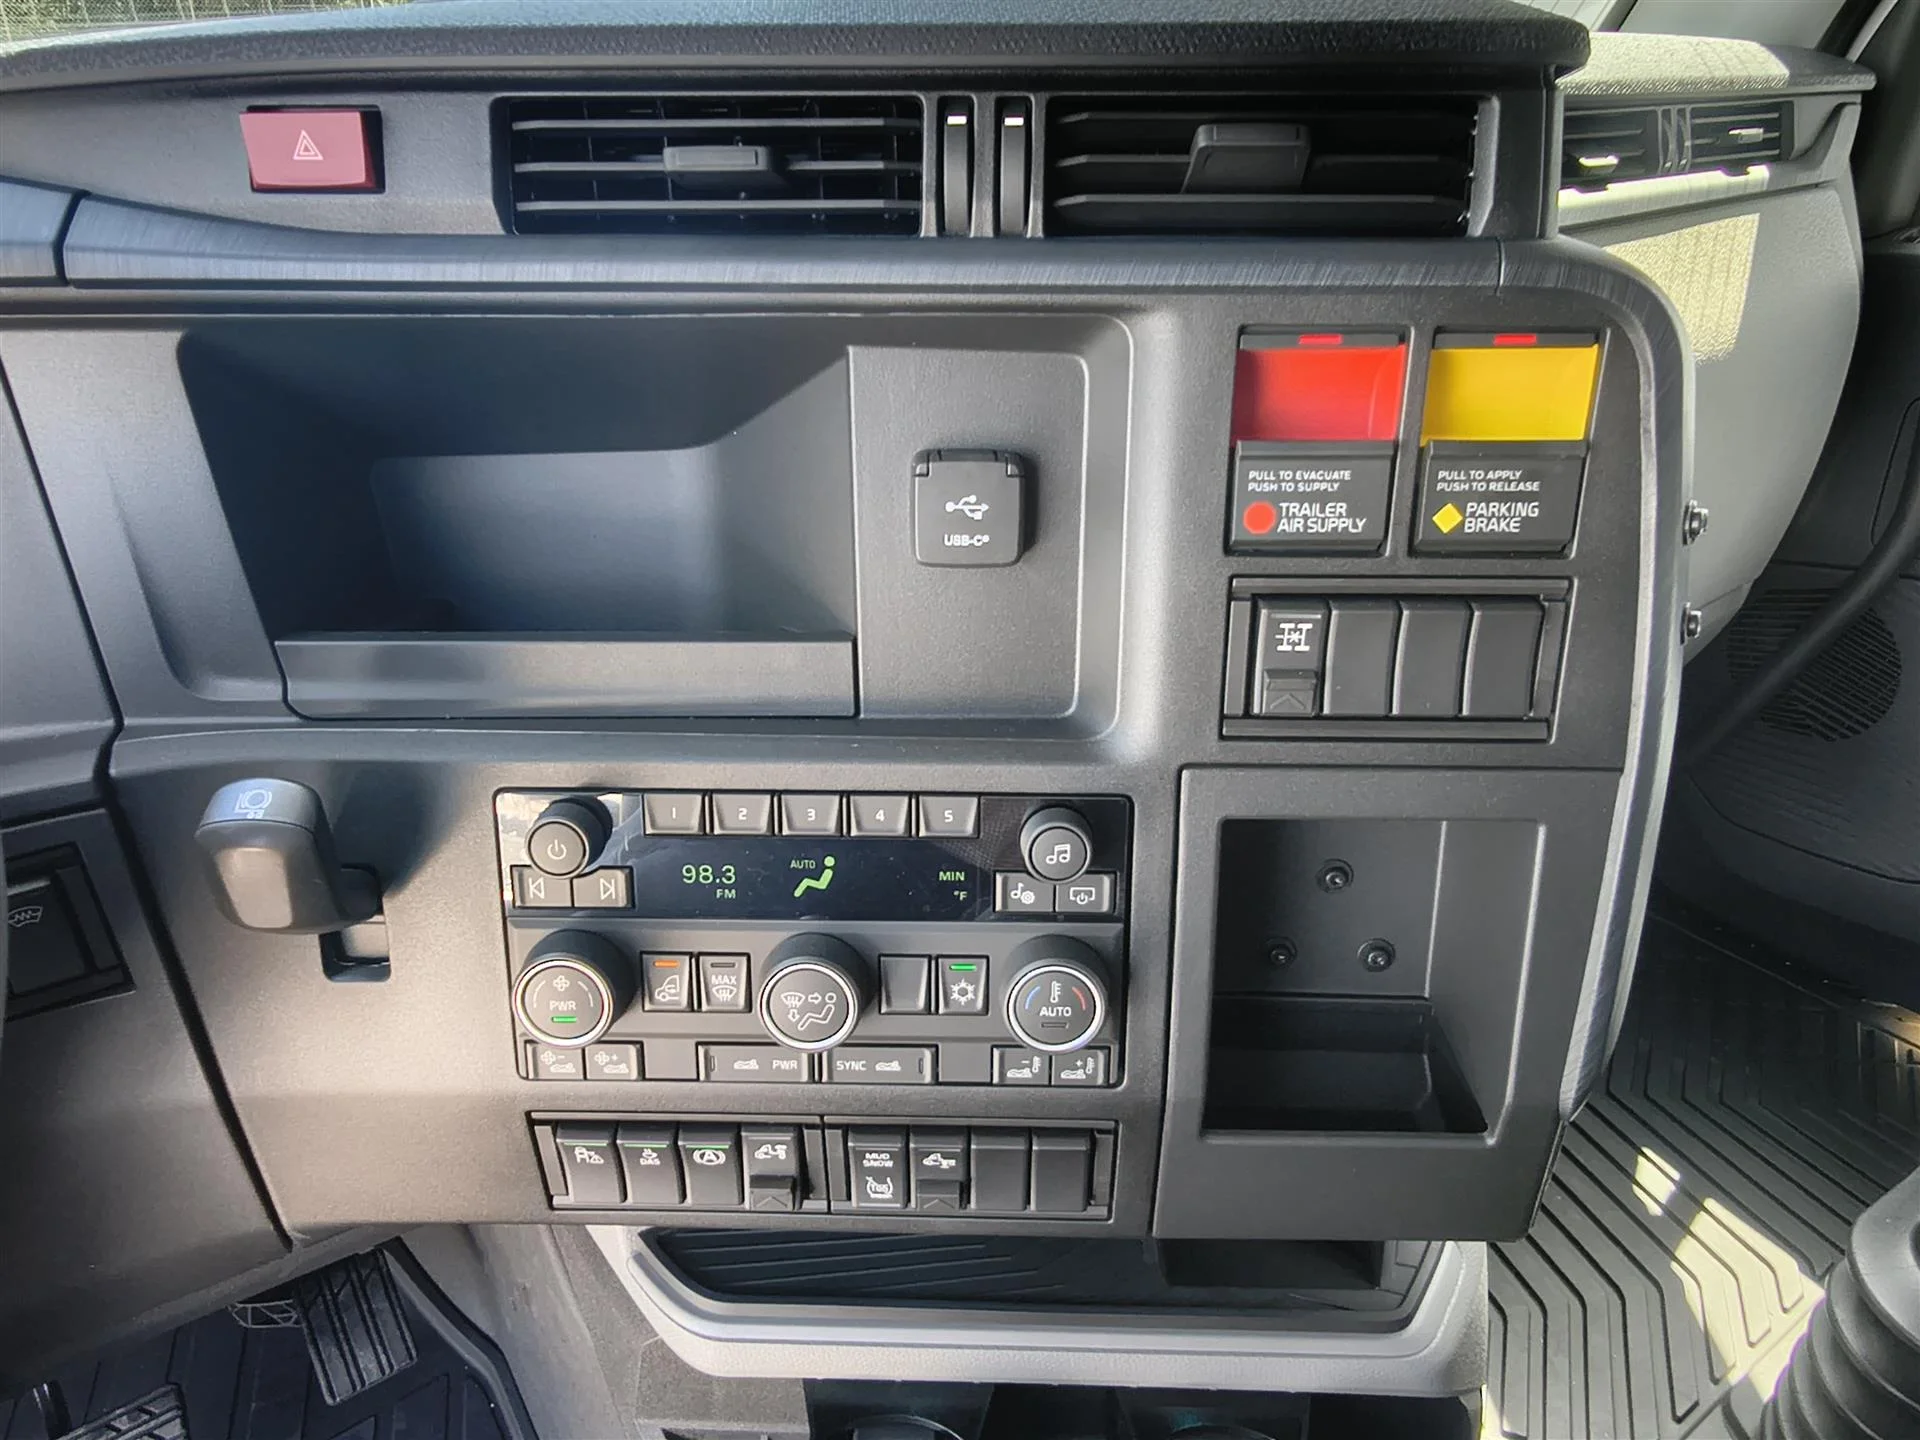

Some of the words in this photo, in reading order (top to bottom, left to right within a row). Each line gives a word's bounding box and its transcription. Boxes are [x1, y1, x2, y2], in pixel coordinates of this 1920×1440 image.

[1248, 470, 1276, 480] PULL
[1279, 470, 1293, 480] TO
[1295, 470, 1351, 480] EVACUATE
[1437, 470, 1466, 480] PULL
[1469, 470, 1484, 480] TO
[1486, 470, 1522, 480] APPLY
[1248, 482, 1278, 492] PUSH
[1280, 482, 1295, 492] TO
[1297, 482, 1340, 492] SUPPLY
[1436, 482, 1469, 491] PUSH
[1471, 482, 1486, 491] TO
[1488, 481, 1541, 491] RELEASE
[1279, 502, 1348, 517] TRAILER
[1466, 502, 1539, 517] PARKING
[1277, 518, 1304, 533] AIR
[1307, 518, 1367, 533] SUPPLY
[1464, 517, 1521, 533] BRAKE
[738, 808, 748, 820] 2
[807, 809, 817, 821] 3
[875, 809, 886, 821] 4
[944, 810, 954, 823] 5
[790, 859, 816, 870] AUTO
[682, 865, 737, 884] 98.3
[939, 870, 966, 882] MIN
[716, 888, 737, 900] FM
[711, 975, 737, 985] MAX
[550, 1000, 577, 1011] PWR
[1040, 1007, 1072, 1017] AUTO
[772, 1059, 799, 1070] PWR
[836, 1060, 867, 1071] SYNC
[640, 1156, 661, 1166] DAS
[865, 1152, 890, 1160] MUD
[863, 1160, 894, 1168] SNOW
